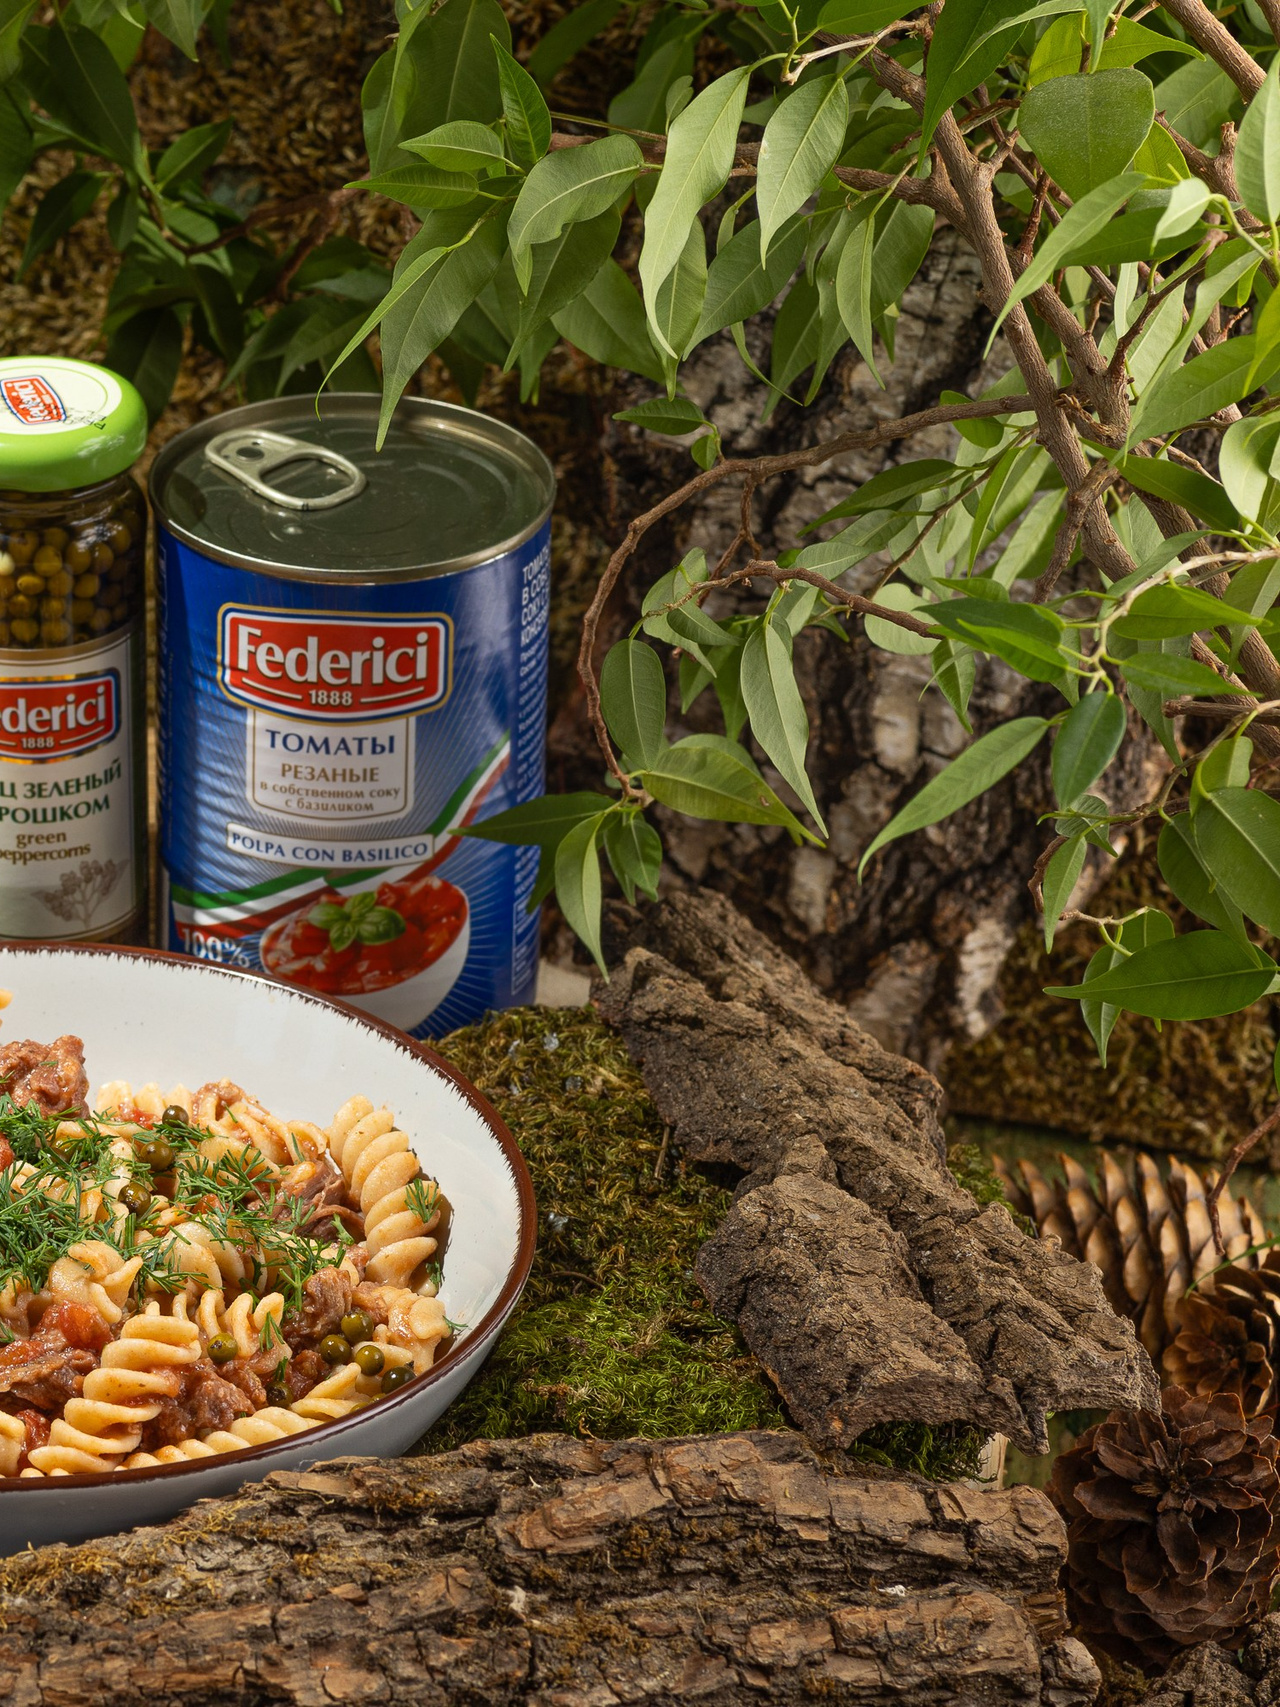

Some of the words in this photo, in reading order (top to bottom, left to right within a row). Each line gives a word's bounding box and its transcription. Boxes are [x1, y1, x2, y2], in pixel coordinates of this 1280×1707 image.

[237, 624, 429, 686] Federici
[308, 689, 353, 706] 1888
[21, 737, 55, 749] 1888
[265, 729, 395, 756] ТОМАТЫ
[23, 758, 122, 800] ЗЕЛЕНЫЙ
[280, 763, 380, 784] РЕЗАНЫЕ
[260, 782, 268, 791] в
[272, 782, 365, 801] собственном
[368, 785, 400, 802] соку
[285, 800, 293, 809] с
[296, 797, 374, 813] базиликом
[16, 832, 67, 849] green
[231, 832, 286, 858] POLPA
[292, 845, 336, 862] CON
[342, 842, 428, 863] BASILICO
[182, 928, 250, 968] 100%
